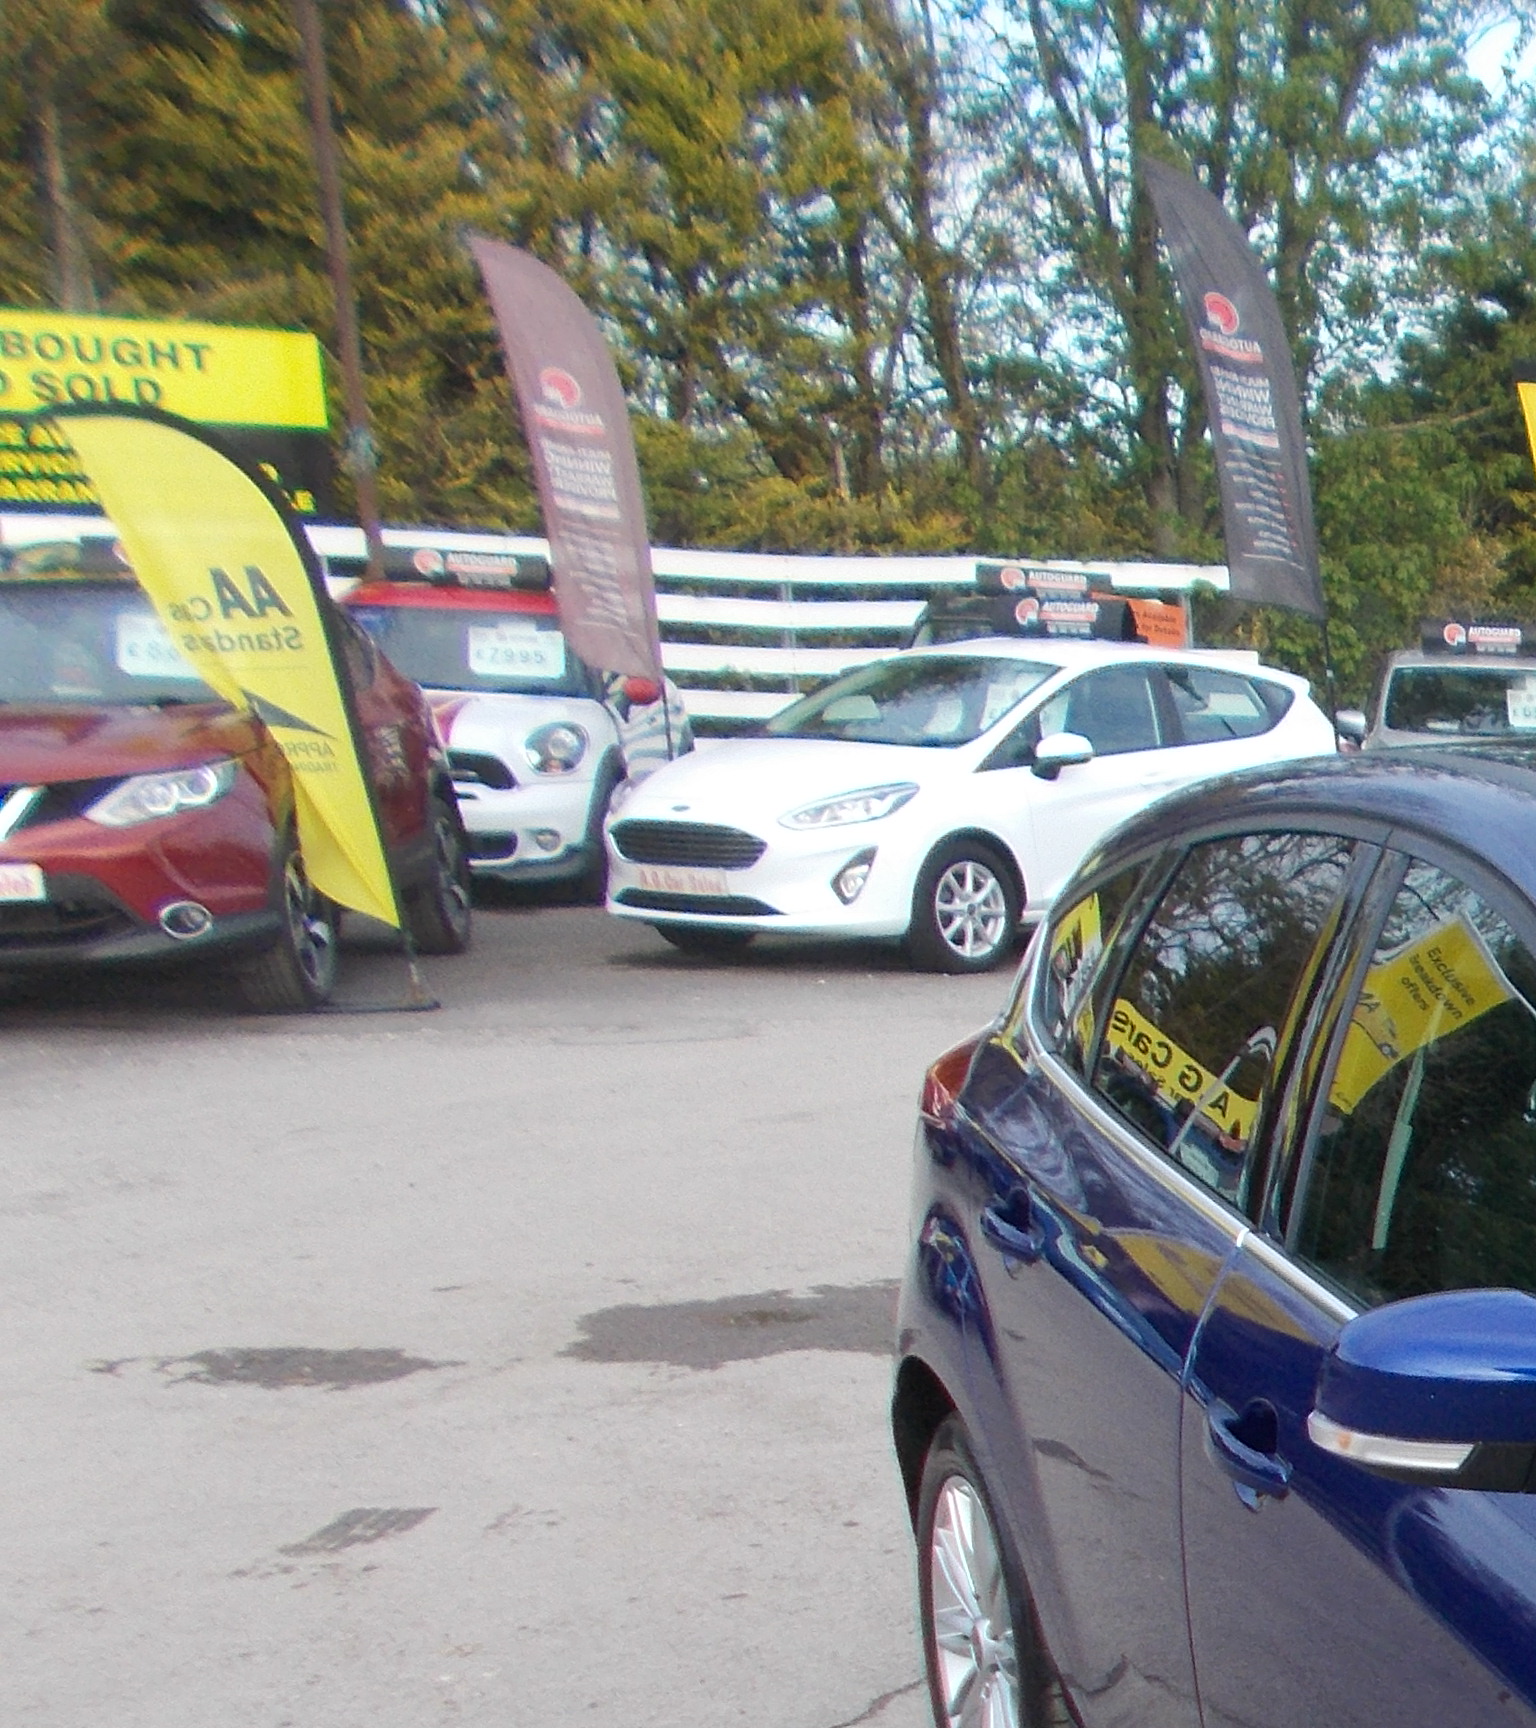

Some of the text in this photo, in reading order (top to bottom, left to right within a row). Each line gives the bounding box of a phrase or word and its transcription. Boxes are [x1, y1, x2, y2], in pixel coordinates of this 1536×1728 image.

[0, 330, 210, 371] BOUGHT
[31, 370, 163, 407] SOLD
[1468, 626, 1521, 638] AUTOGUARD
[1400, 976, 1431, 1012] offers
[1426, 947, 1476, 1007] Exclusive
